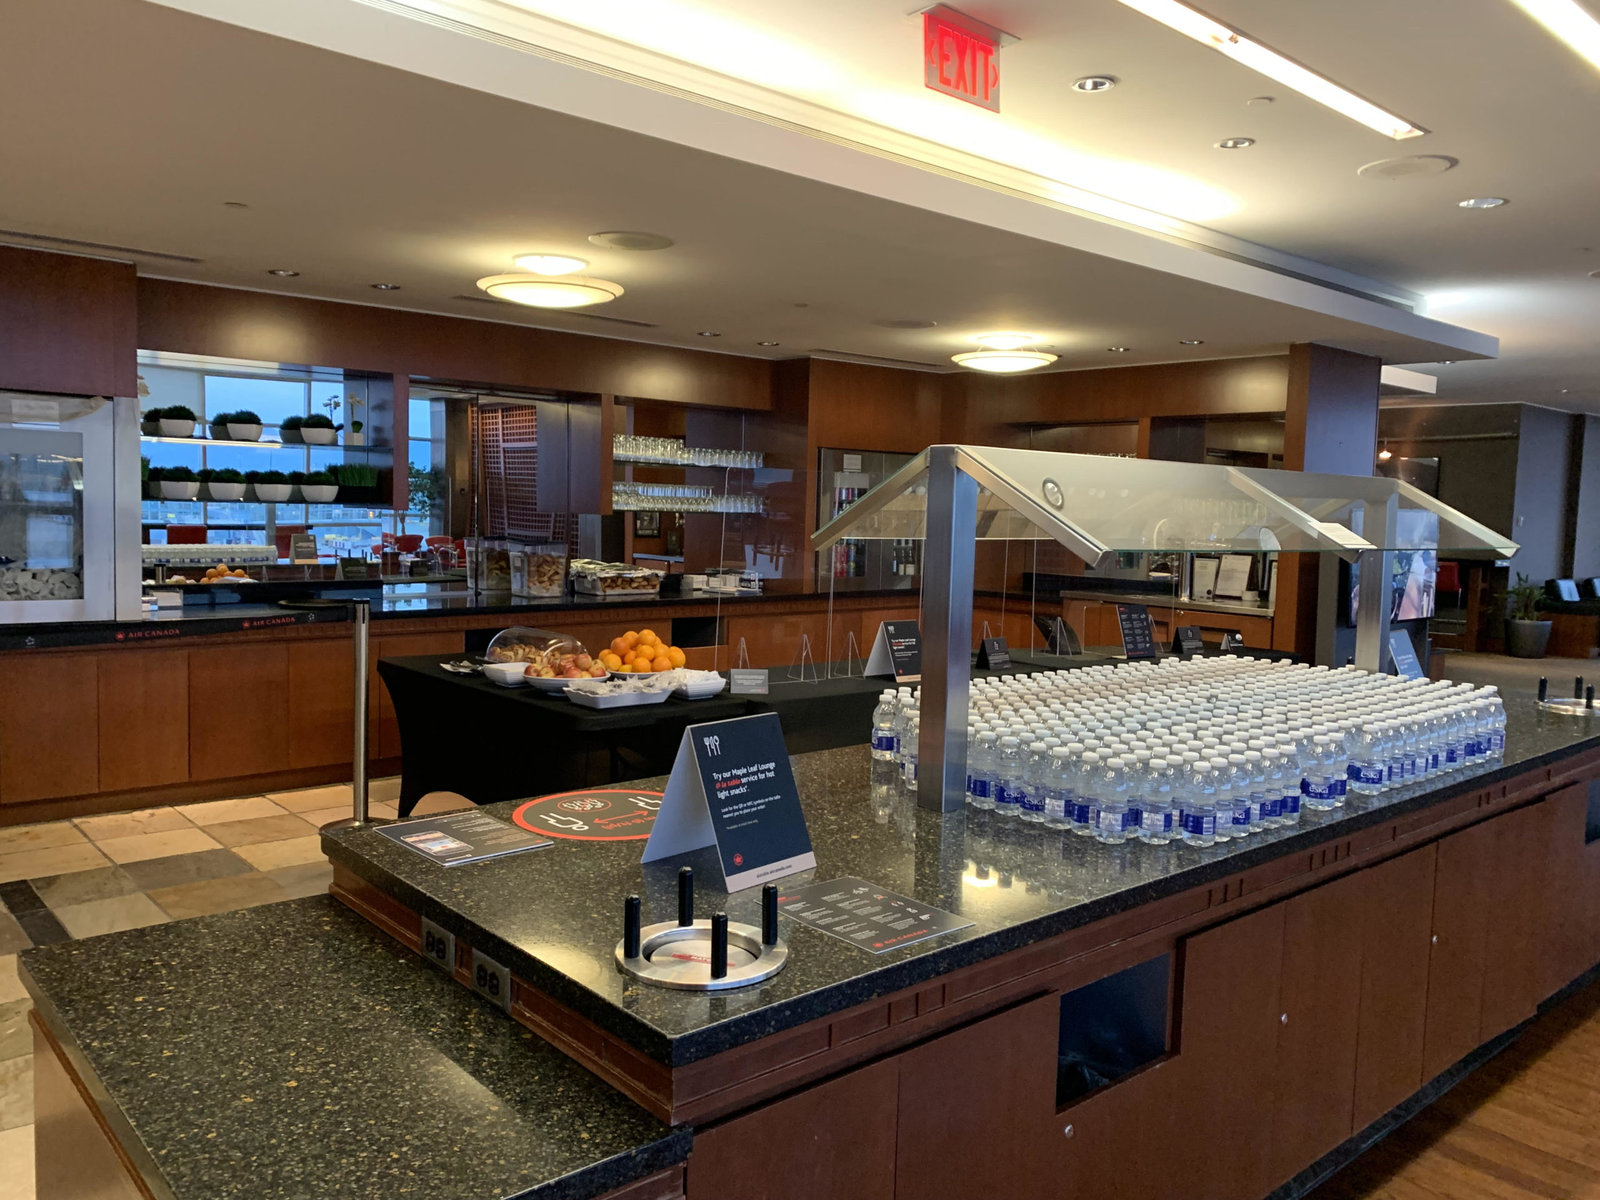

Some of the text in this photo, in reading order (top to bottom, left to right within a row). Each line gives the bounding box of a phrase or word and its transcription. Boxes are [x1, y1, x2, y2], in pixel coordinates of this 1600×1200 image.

[937, 24, 995, 103] EXIT
[253, 616, 296, 626] AIR CANADA
[128, 629, 180, 639] AIR CANADA
[712, 772, 722, 781] Try
[731, 767, 747, 776] Maple
[747, 764, 758, 773] Leaf
[759, 762, 776, 770] Lounge
[741, 775, 758, 783] service
[717, 789, 729, 799] light
